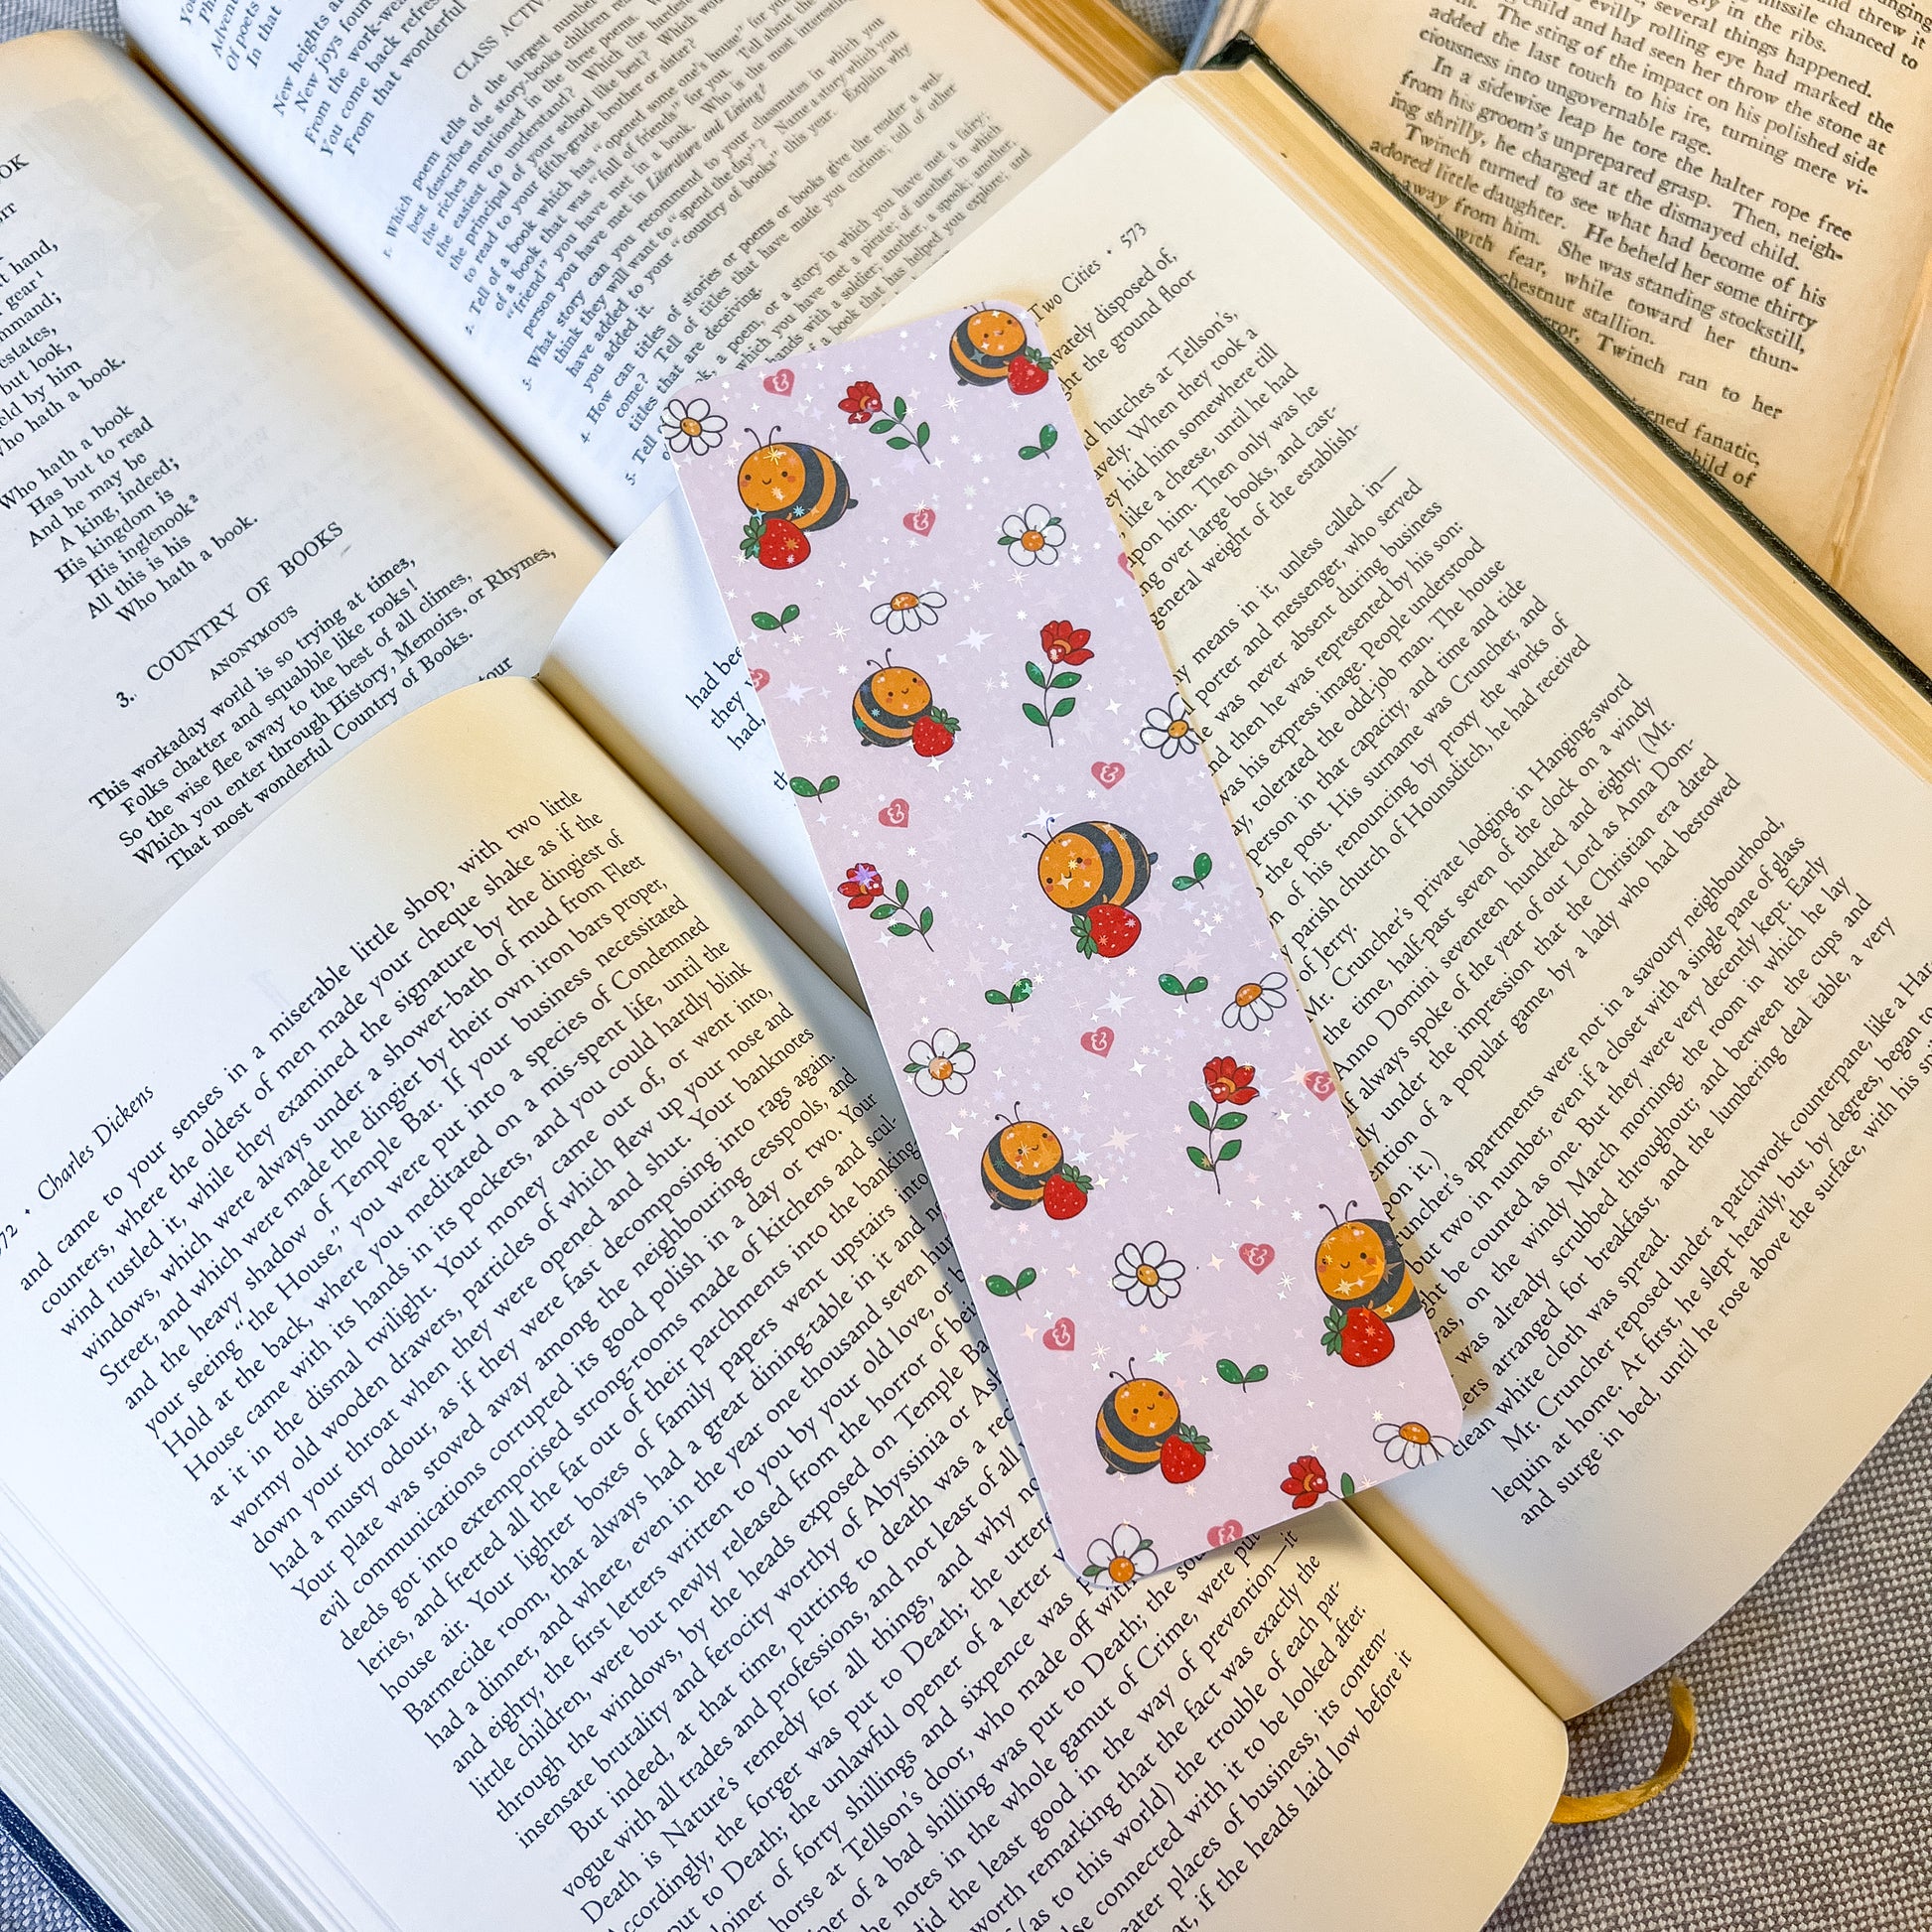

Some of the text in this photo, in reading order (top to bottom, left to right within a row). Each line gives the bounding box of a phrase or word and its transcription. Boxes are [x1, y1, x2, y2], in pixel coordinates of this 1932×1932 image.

[422, 15, 639, 245] the riches mentioned in the three poems.
[463, 38, 696, 283] to read to your fifth-grade brother or sister?
[1405, 123, 1827, 307] Twinch turned to see what had become of his
[1429, 7, 1868, 195] added the last touch to his ire, turning mere vi-
[586, 389, 612, 425] How
[614, 362, 635, 386] can
[633, 325, 666, 358] titles
[667, 304, 681, 322] of
[682, 267, 722, 307] stories
[723, 252, 737, 267] or
[738, 218, 775, 254] poems
[776, 205, 790, 218] or
[788, 176, 825, 205] books
[826, 153, 851, 178] give
[850, 135, 872, 152] the
[873, 102, 906, 134] reader
[1027, 222, 1147, 327] Two Cities 573
[29, 453, 147, 548] And he may be
[60, 457, 180, 552] A king, indeed;
[115, 521, 343, 708] 3. COUNTRY OF BOOKS
[1150, 425, 1359, 630] general weight of the establish-
[1195, 477, 1423, 707] porter and messenger, who served
[87, 558, 415, 809] This workaday world is so trying at times,
[165, 631, 473, 870] That most wonderful Country of Books.
[209, 605, 298, 681] ANONYMOUS
[1332, 720, 1675, 1081] Anno Domini seventeen hundred and eighty. (Mr.
[20, 790, 582, 1291] and came to your senses in a miserable little shop, with two little
[125, 893, 689, 1410] and the heavy shadow of Temple Bar. If your business necessitated
[0, 1085, 153, 1256] 72 Charles Dickens
[1521, 1074, 1919, 1525] and surge in bed, until he rose above the surface, with his
[580, 1869, 641, 1925] Death
[640, 1850, 662, 1869] is
[659, 1775, 739, 1849] Nature's
[743, 1711, 808, 1775] remedy
[808, 1680, 839, 1711] for
[845, 1647, 870, 1679] all
[872, 1594, 933, 1650] things,
[937, 1543, 973, 1587] and
[974, 1504, 1015, 1545] why
[1028, 1556, 1319, 1884] remarking that the fact was exactly the
